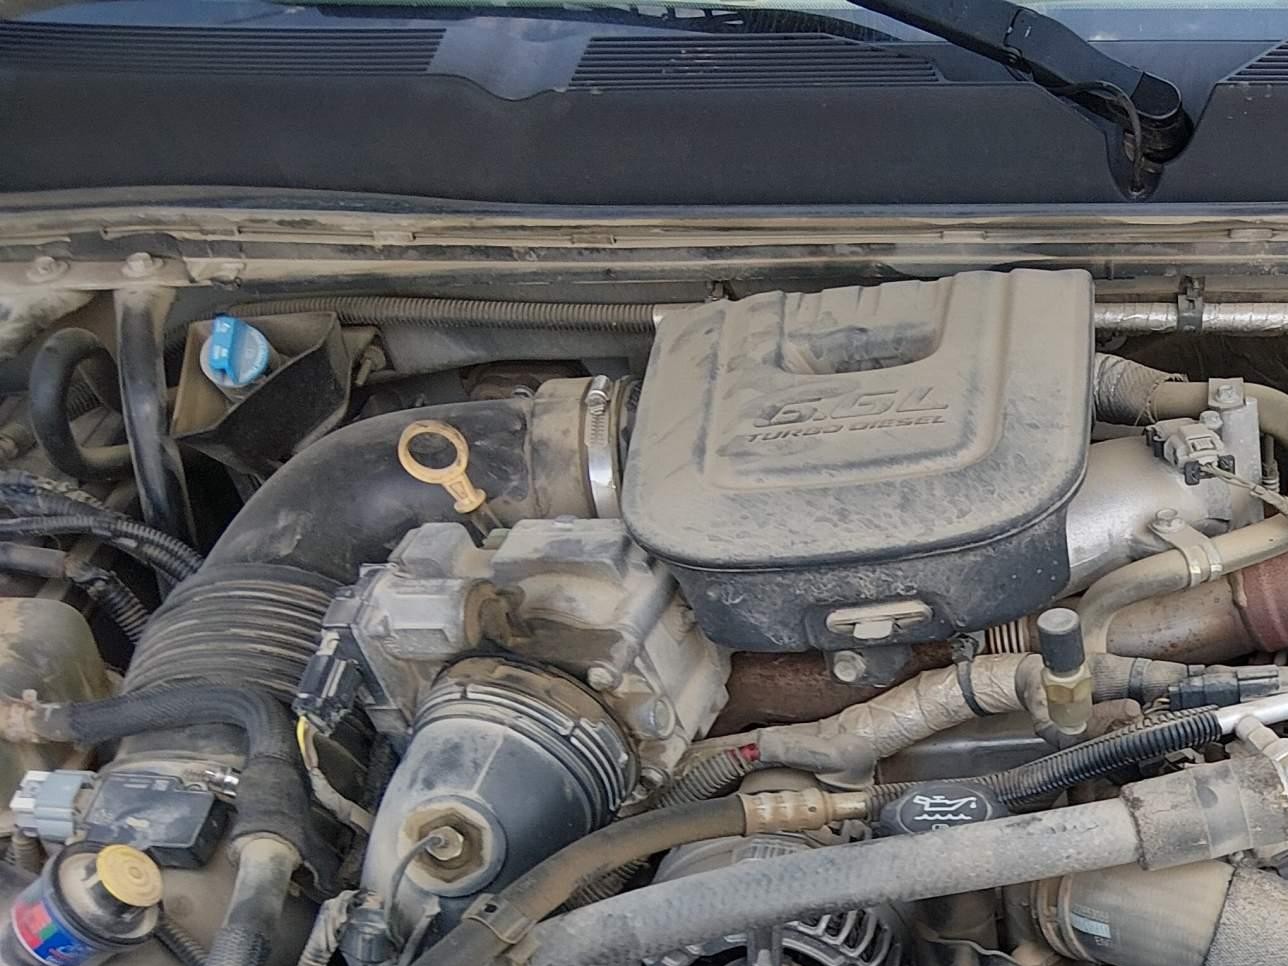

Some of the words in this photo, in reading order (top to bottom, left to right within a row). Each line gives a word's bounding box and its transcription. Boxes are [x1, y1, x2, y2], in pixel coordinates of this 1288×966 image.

[752, 386, 949, 428] 6.6L
[747, 424, 844, 442] TURBO
[847, 415, 944, 431] DIESEL
